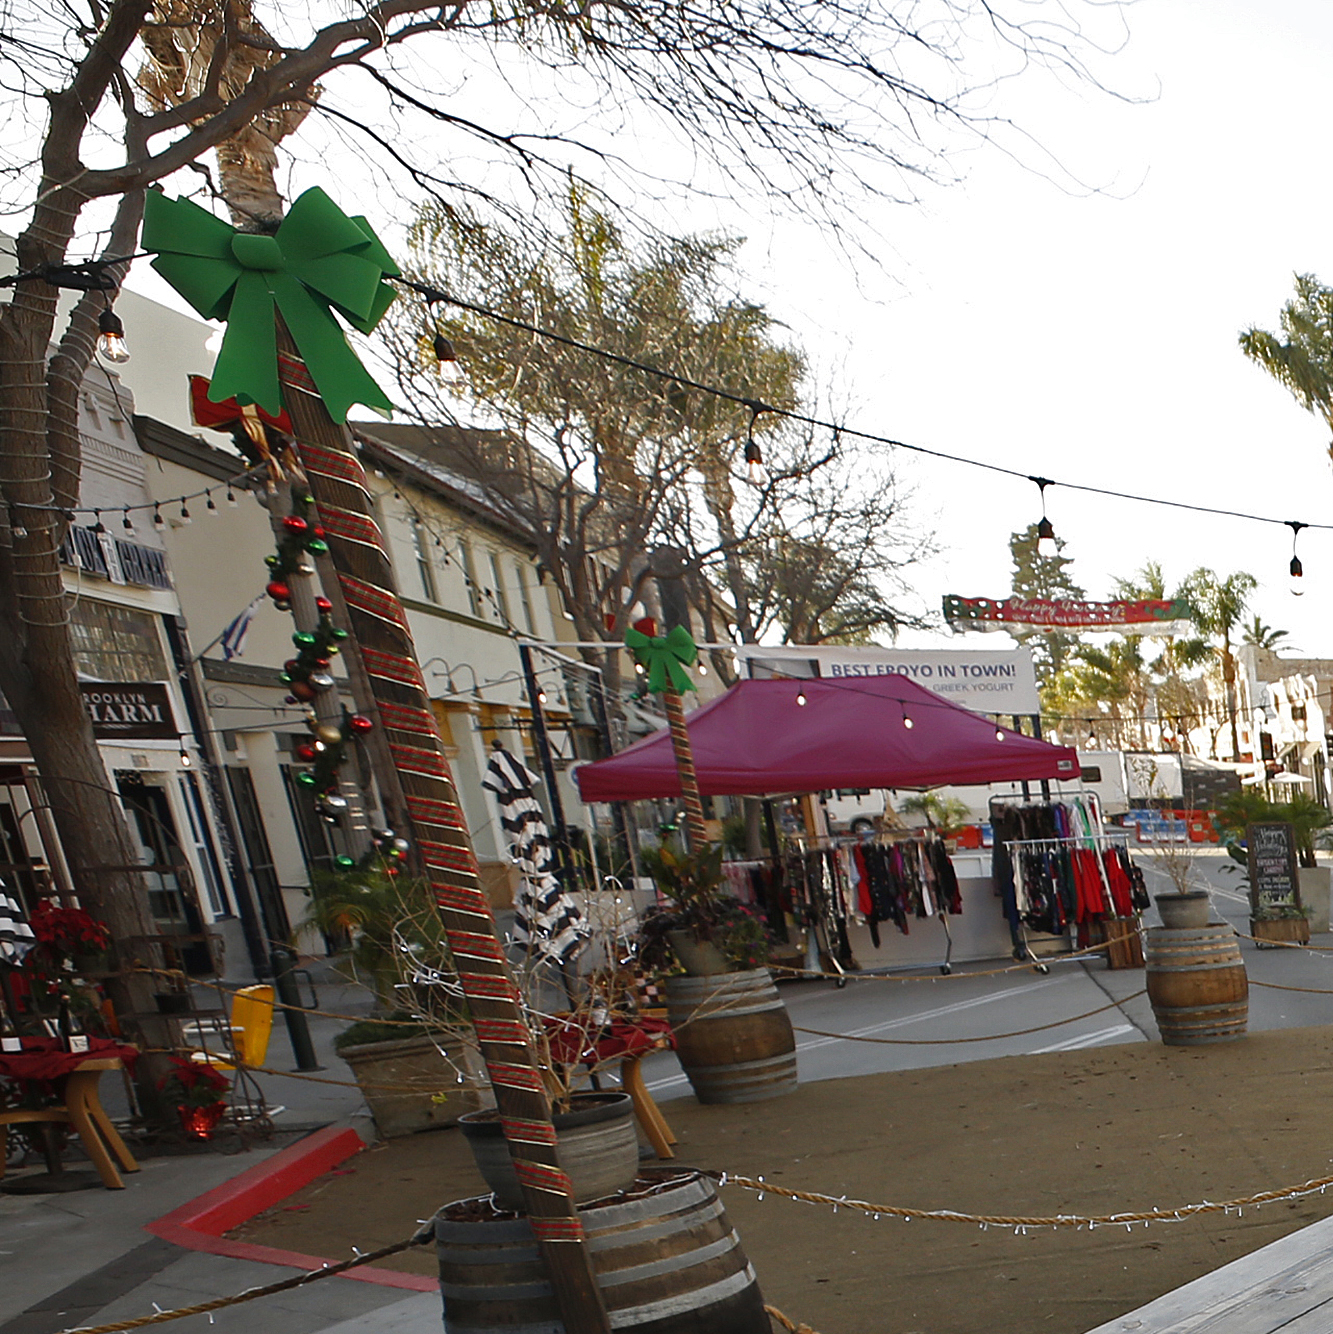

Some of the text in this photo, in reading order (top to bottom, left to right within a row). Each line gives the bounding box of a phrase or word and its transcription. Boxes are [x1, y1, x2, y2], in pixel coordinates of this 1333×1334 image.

[832, 663, 871, 677] BEST
[938, 664, 957, 677] IN
[959, 664, 1016, 677] TOWN!
[934, 683, 1015, 692] GREEK YOGURT
[82, 692, 147, 704] ROOKLYN
[88, 704, 164, 722] HARM
